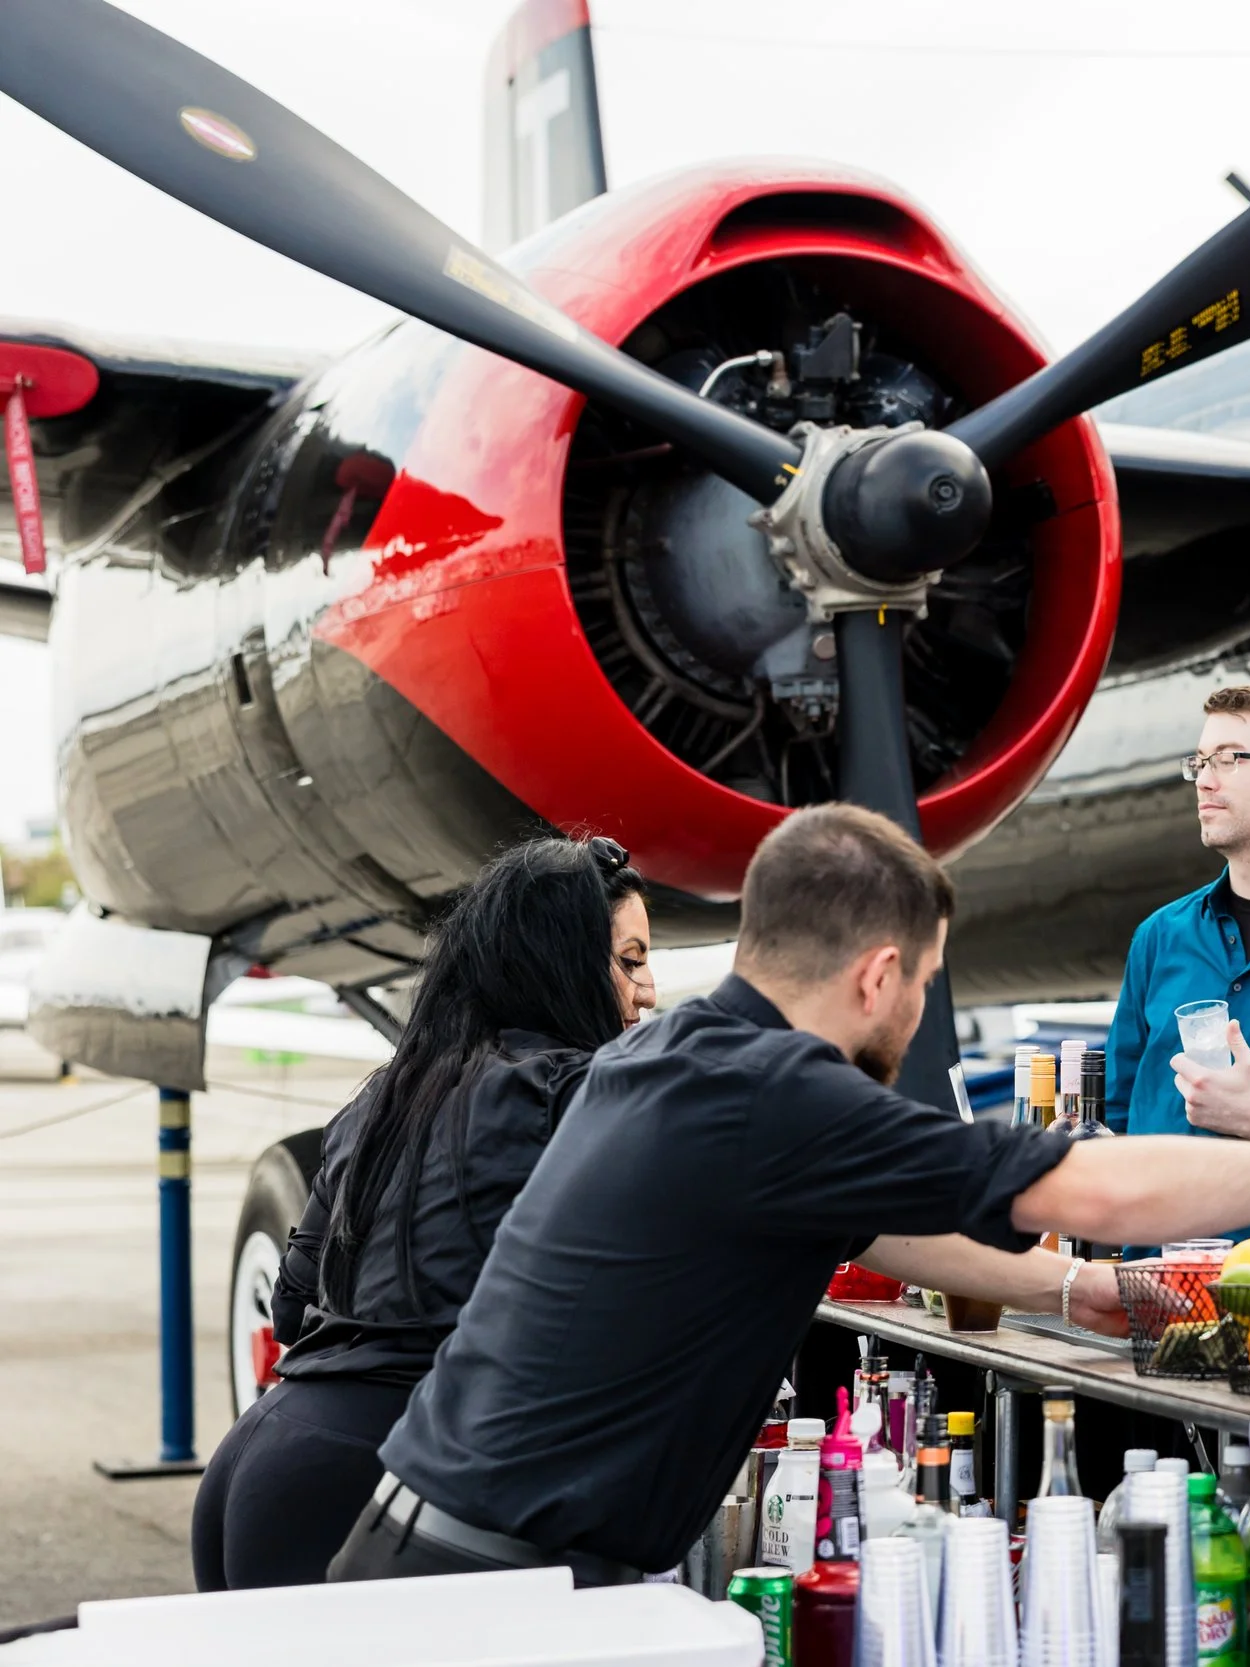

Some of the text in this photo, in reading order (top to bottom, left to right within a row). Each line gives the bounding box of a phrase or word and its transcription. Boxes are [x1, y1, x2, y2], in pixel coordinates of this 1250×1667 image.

[763, 1529, 789, 1543] COLD
[762, 1542, 790, 1557] BREW
[757, 1595, 785, 1667] prite
